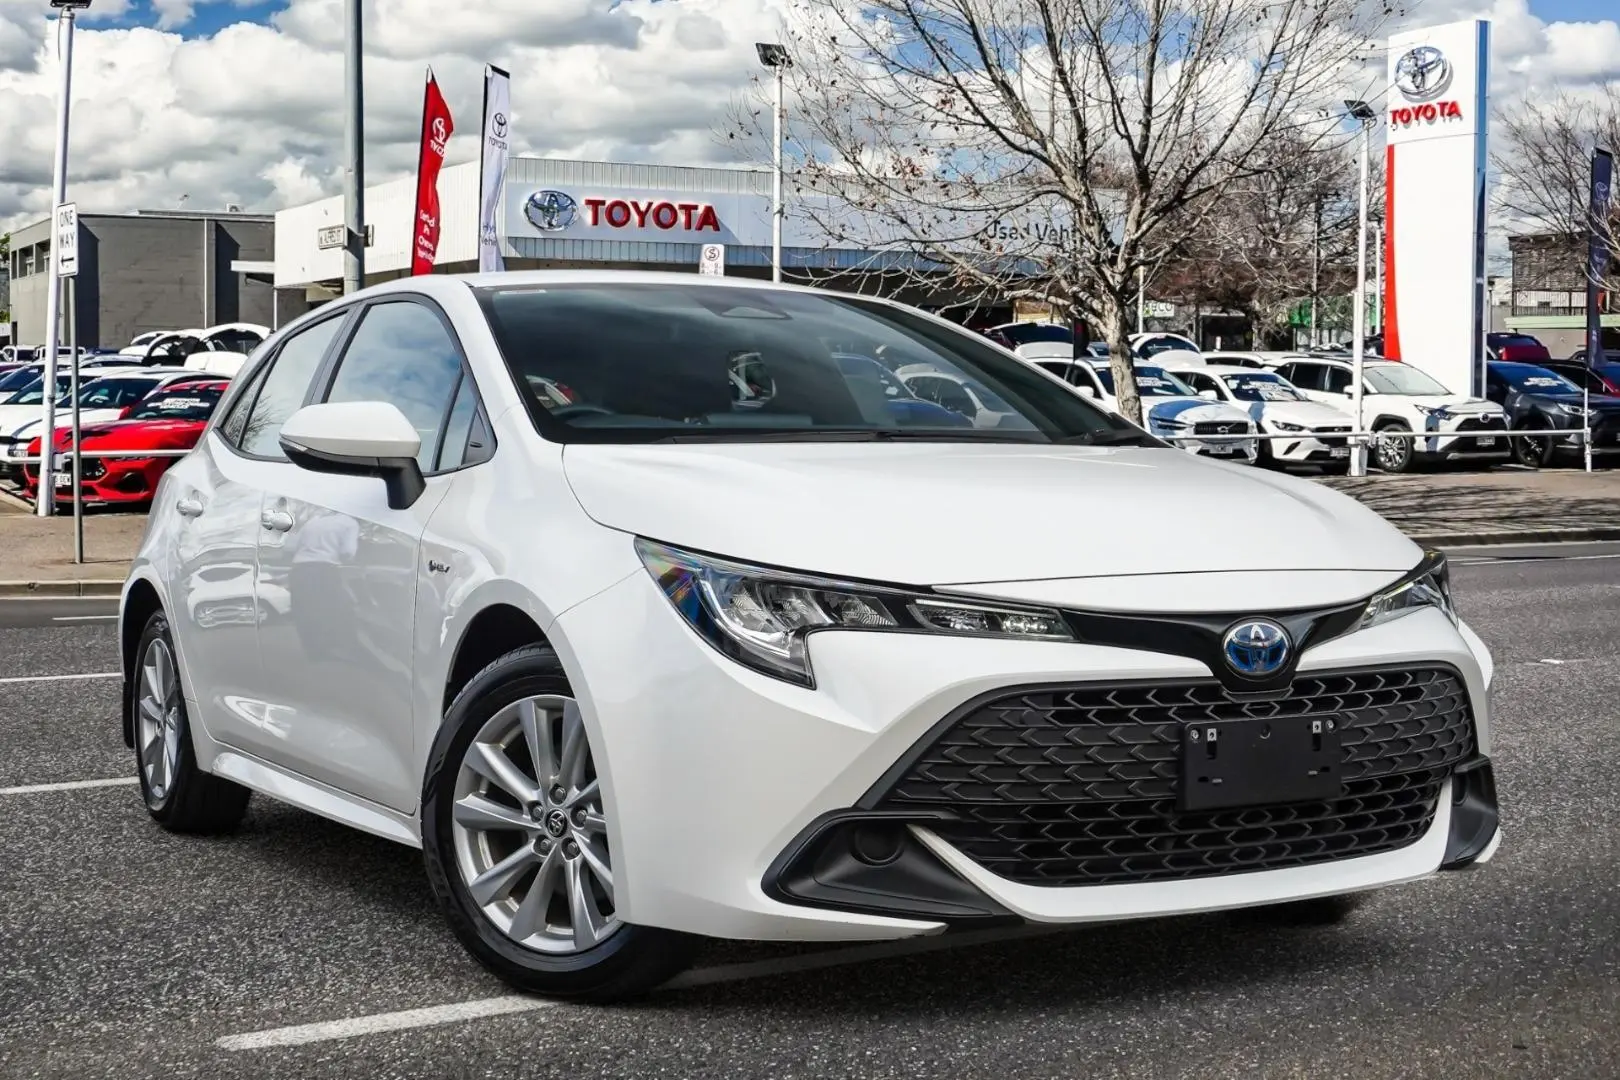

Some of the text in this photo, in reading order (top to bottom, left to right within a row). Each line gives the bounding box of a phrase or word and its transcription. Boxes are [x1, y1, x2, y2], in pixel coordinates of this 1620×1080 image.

[1389, 101, 1462, 124] TOYOTA
[59, 209, 73, 228] ONE
[584, 199, 721, 232] TOYOTA
[59, 232, 75, 249] WAY
